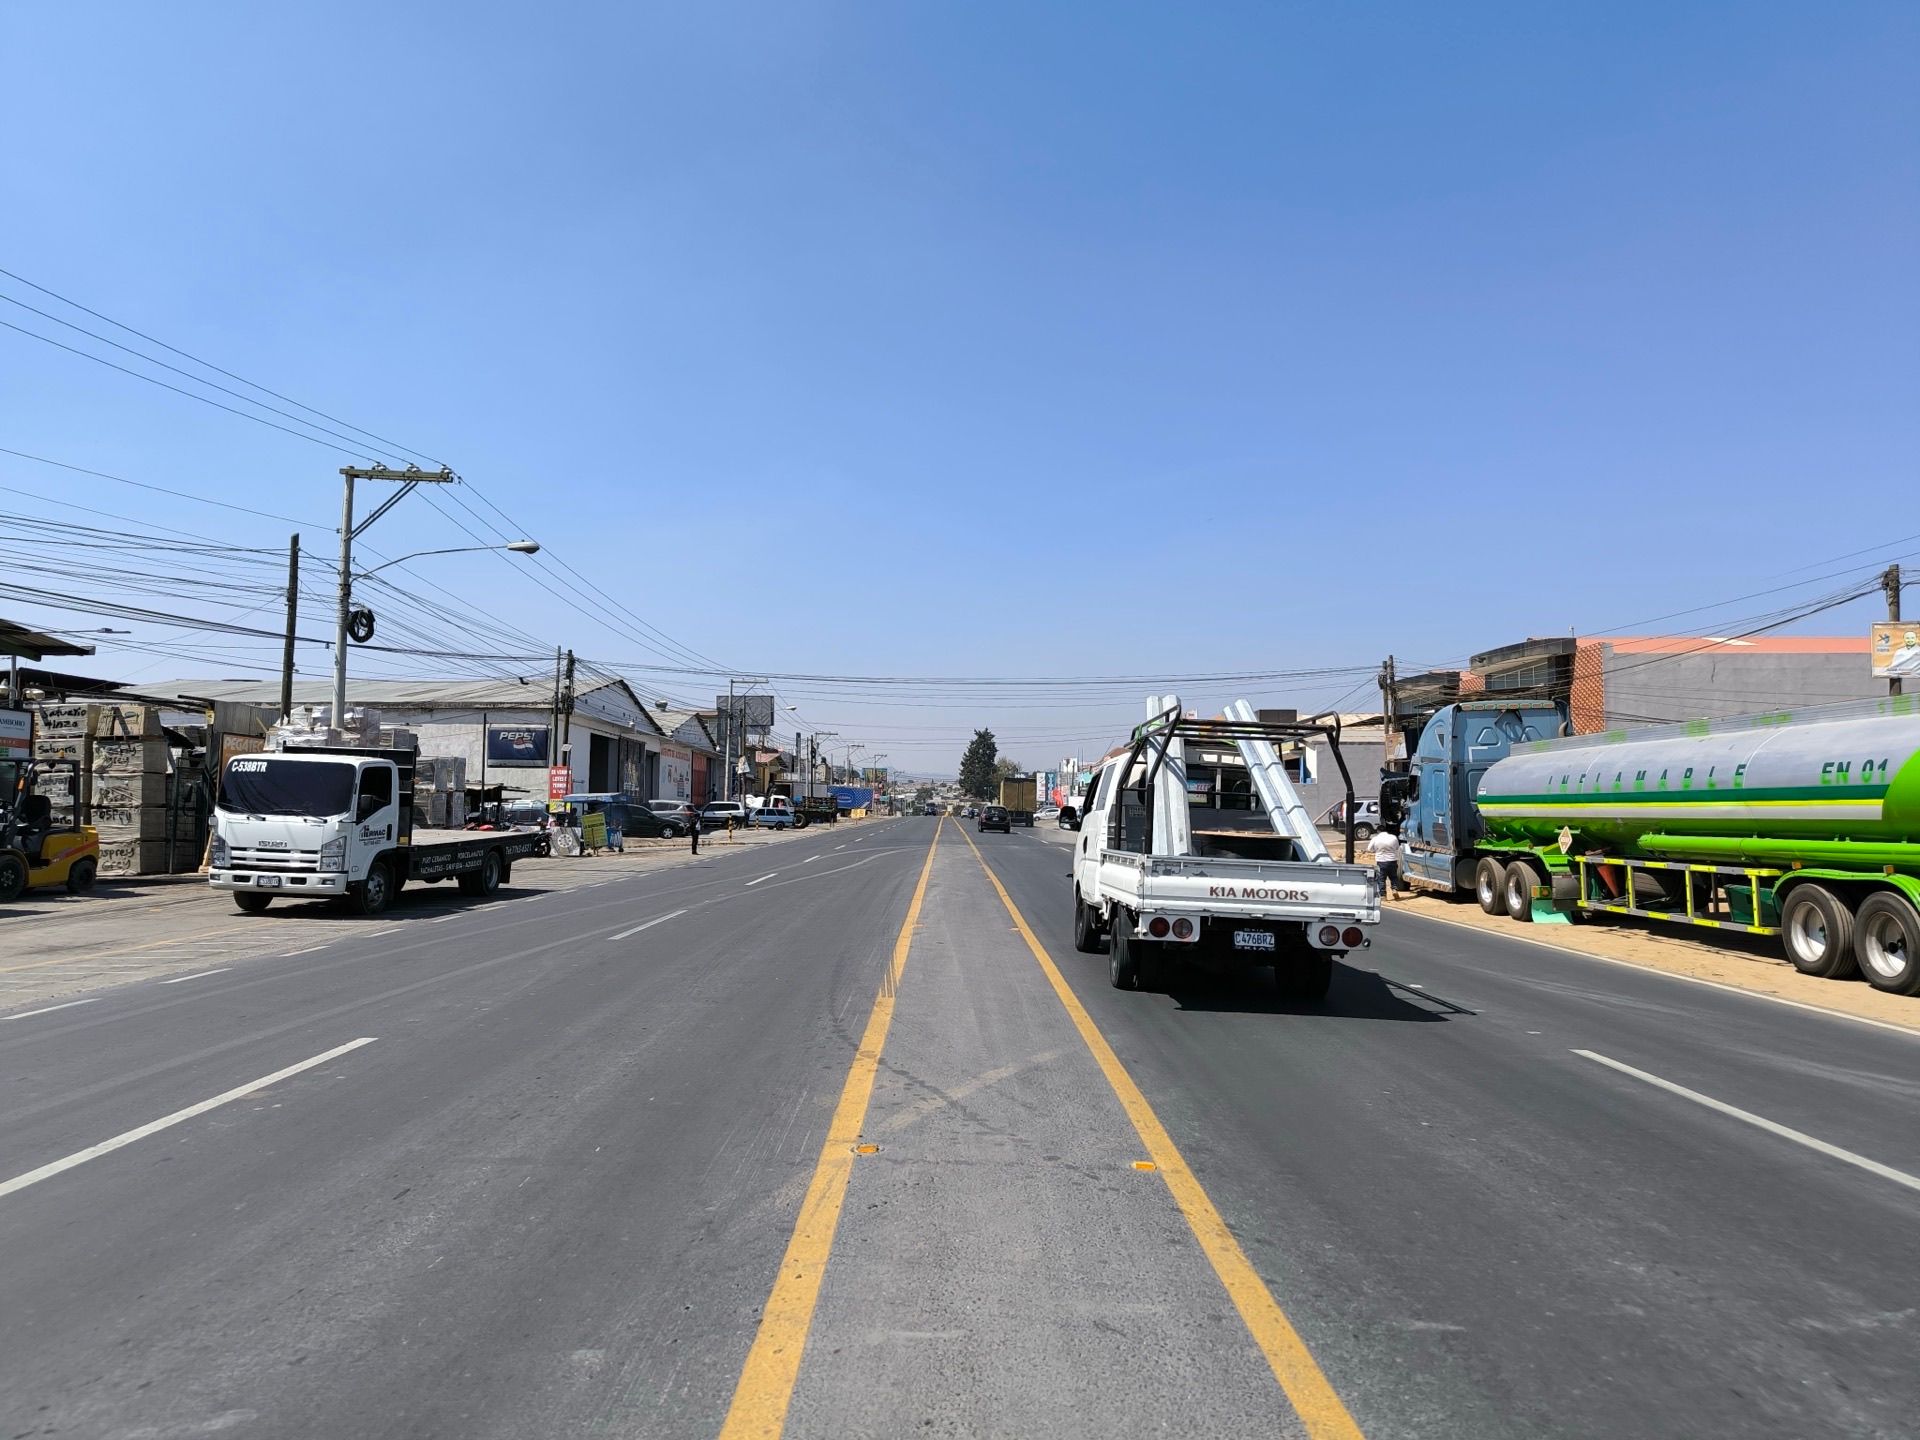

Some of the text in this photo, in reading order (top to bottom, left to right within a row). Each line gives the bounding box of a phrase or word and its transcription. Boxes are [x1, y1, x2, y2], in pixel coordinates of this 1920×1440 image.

[499, 731, 536, 741] PEPSI
[1547, 763, 1747, 793] INFLAMABLE
[1820, 758, 1889, 785] EN 01
[1209, 886, 1309, 902] KIA MOTORS
